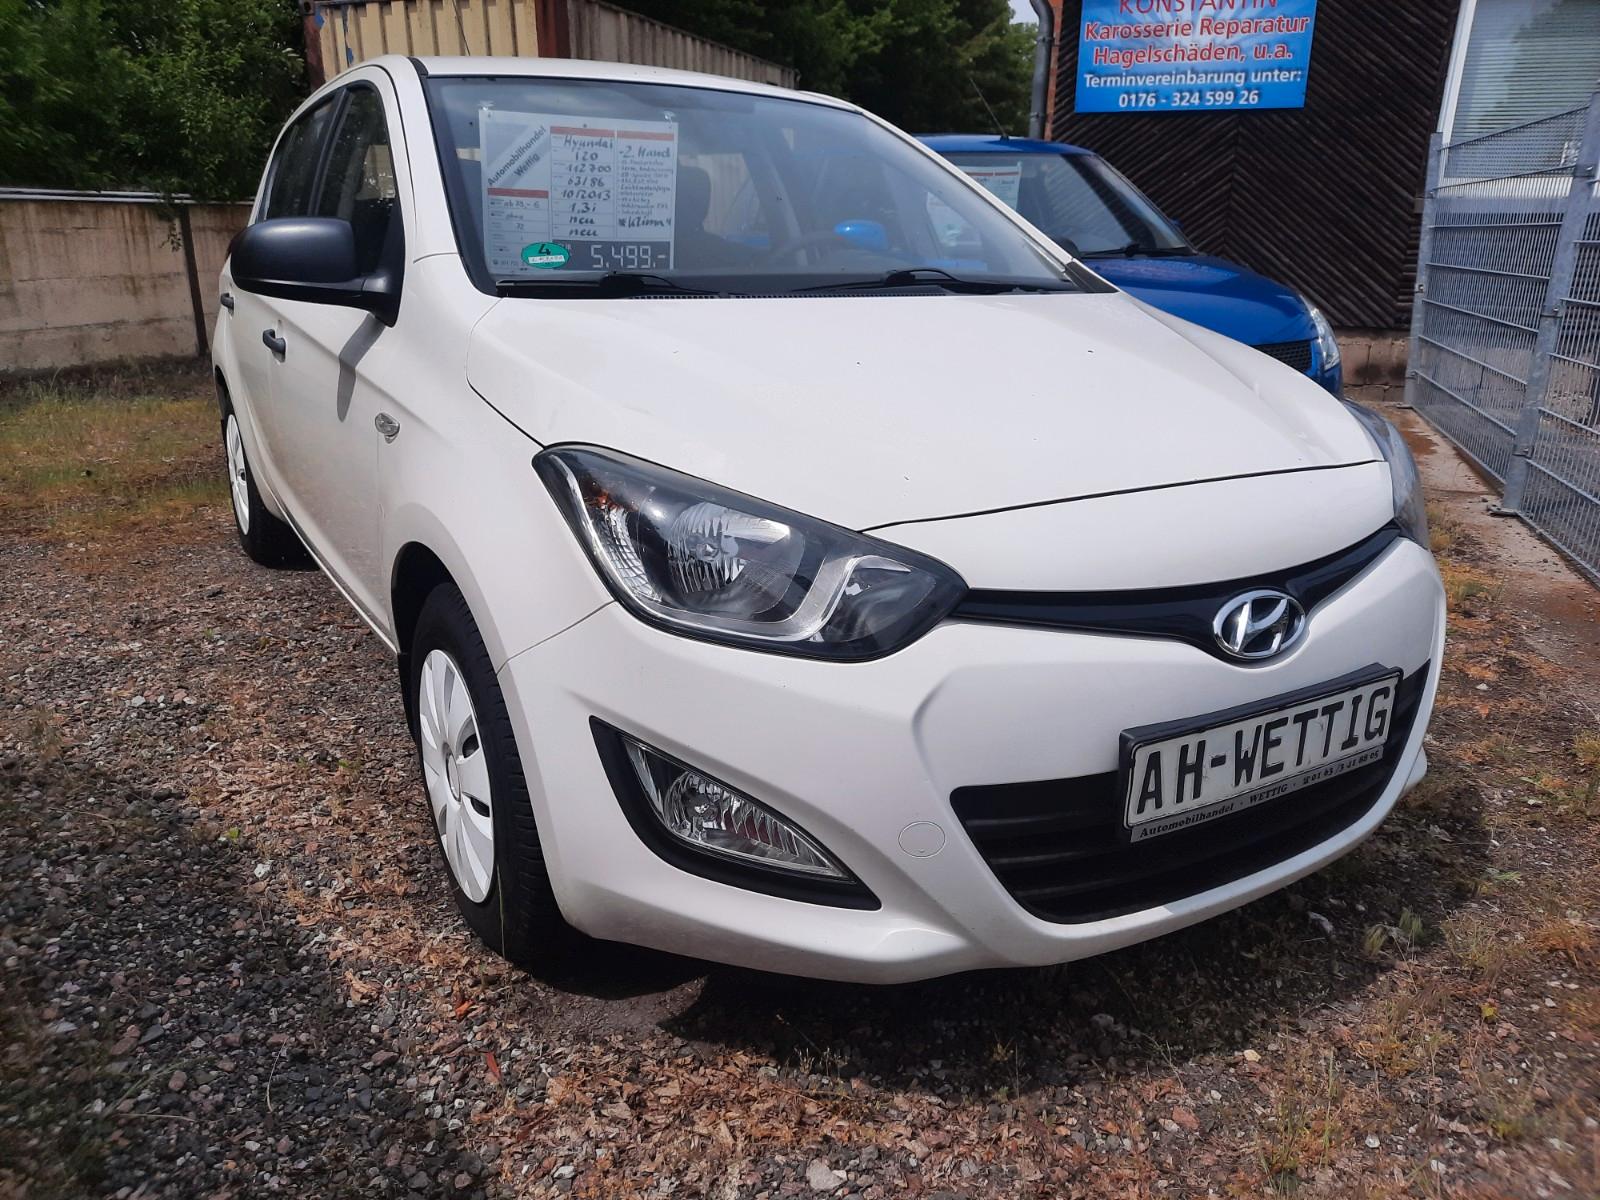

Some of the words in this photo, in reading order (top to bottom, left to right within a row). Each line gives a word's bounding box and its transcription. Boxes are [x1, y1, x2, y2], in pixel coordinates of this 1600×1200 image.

[1085, 18, 1193, 41] Karosserie
[1200, 16, 1310, 38] Reparatur
[1094, 42, 1246, 69] Hagelschäden,
[1253, 43, 1293, 60] u.a.
[1084, 71, 1246, 88] Terminvereinbarung
[1251, 69, 1301, 83] unter:
[1119, 92, 1156, 107] 0176
[1171, 91, 1200, 106] 324
[1205, 90, 1234, 105] 599
[1238, 90, 1260, 104] 26
[564, 134, 613, 152] Hyundai
[638, 147, 671, 158] Hand
[487, 125, 546, 185] Automobilhandel
[513, 151, 541, 178] Wettig
[569, 217, 595, 225] neu
[569, 228, 598, 237] neu
[538, 244, 551, 255] 4
[1137, 687, 1390, 814] AH-WETTIG
[1139, 802, 1234, 838] Automobilhandel
[1249, 783, 1288, 805] WETTIG
